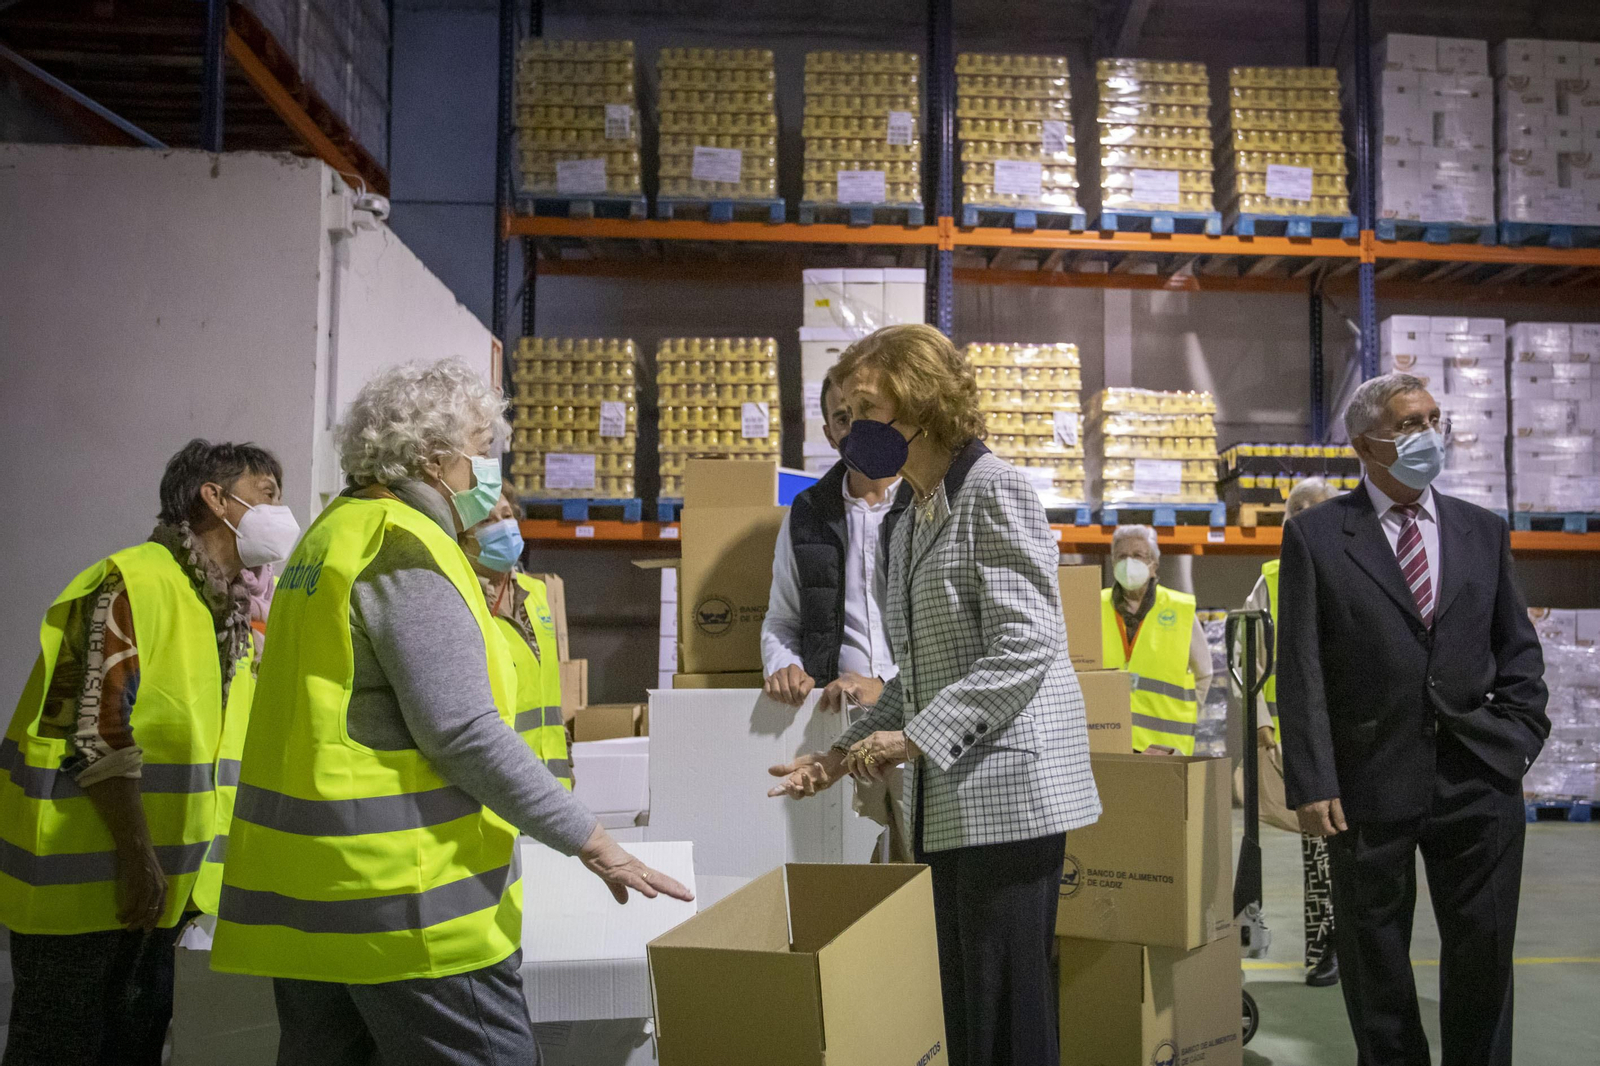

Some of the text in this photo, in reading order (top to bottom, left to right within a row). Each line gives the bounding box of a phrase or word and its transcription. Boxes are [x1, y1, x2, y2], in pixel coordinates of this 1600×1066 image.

[1086, 868, 1175, 885] BANCO DE ALIMENTOS
[1086, 878, 1098, 887] DE
[916, 1041, 940, 1066] MENTOS
